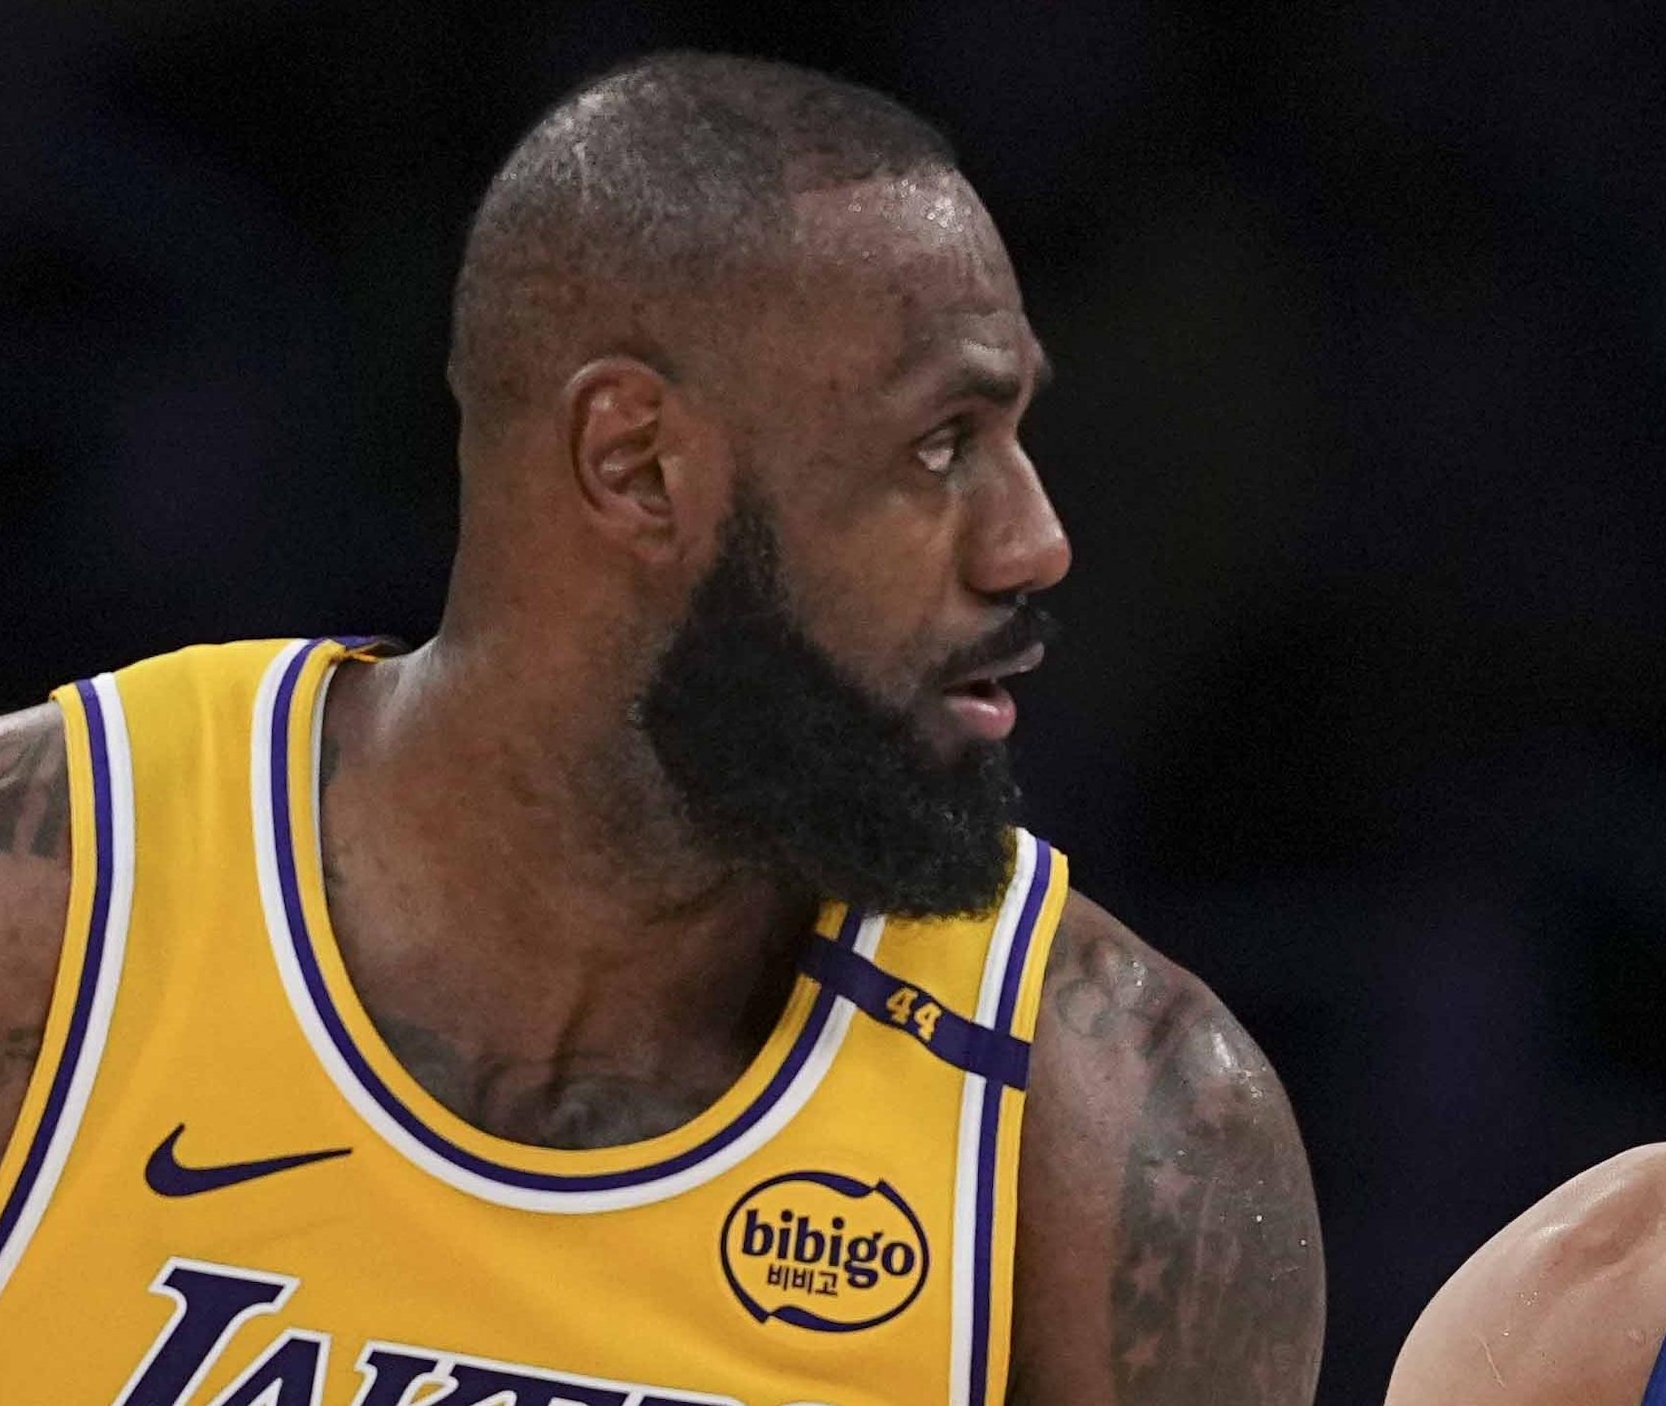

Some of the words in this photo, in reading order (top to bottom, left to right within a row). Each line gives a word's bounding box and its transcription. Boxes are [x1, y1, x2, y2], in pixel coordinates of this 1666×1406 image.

[885, 986, 942, 1043] 44
[741, 1208, 916, 1290] bibigo
[767, 1264, 839, 1297] 비비고
